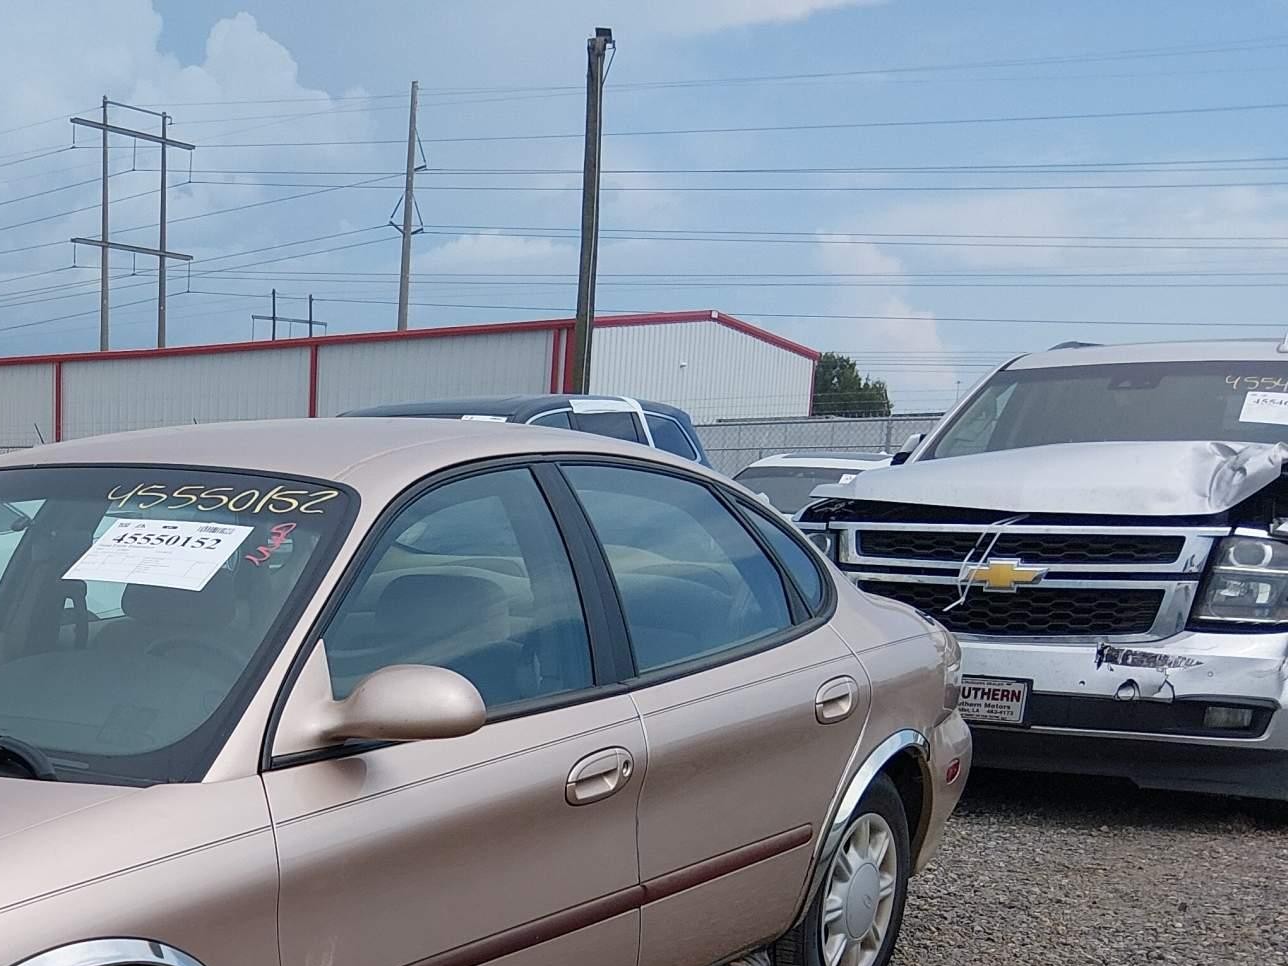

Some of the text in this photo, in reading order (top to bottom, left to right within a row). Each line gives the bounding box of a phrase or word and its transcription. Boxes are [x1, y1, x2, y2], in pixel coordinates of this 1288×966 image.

[107, 483, 339, 515] 45550152
[113, 532, 222, 550] 45550152
[961, 686, 1022, 703] UTHERN
